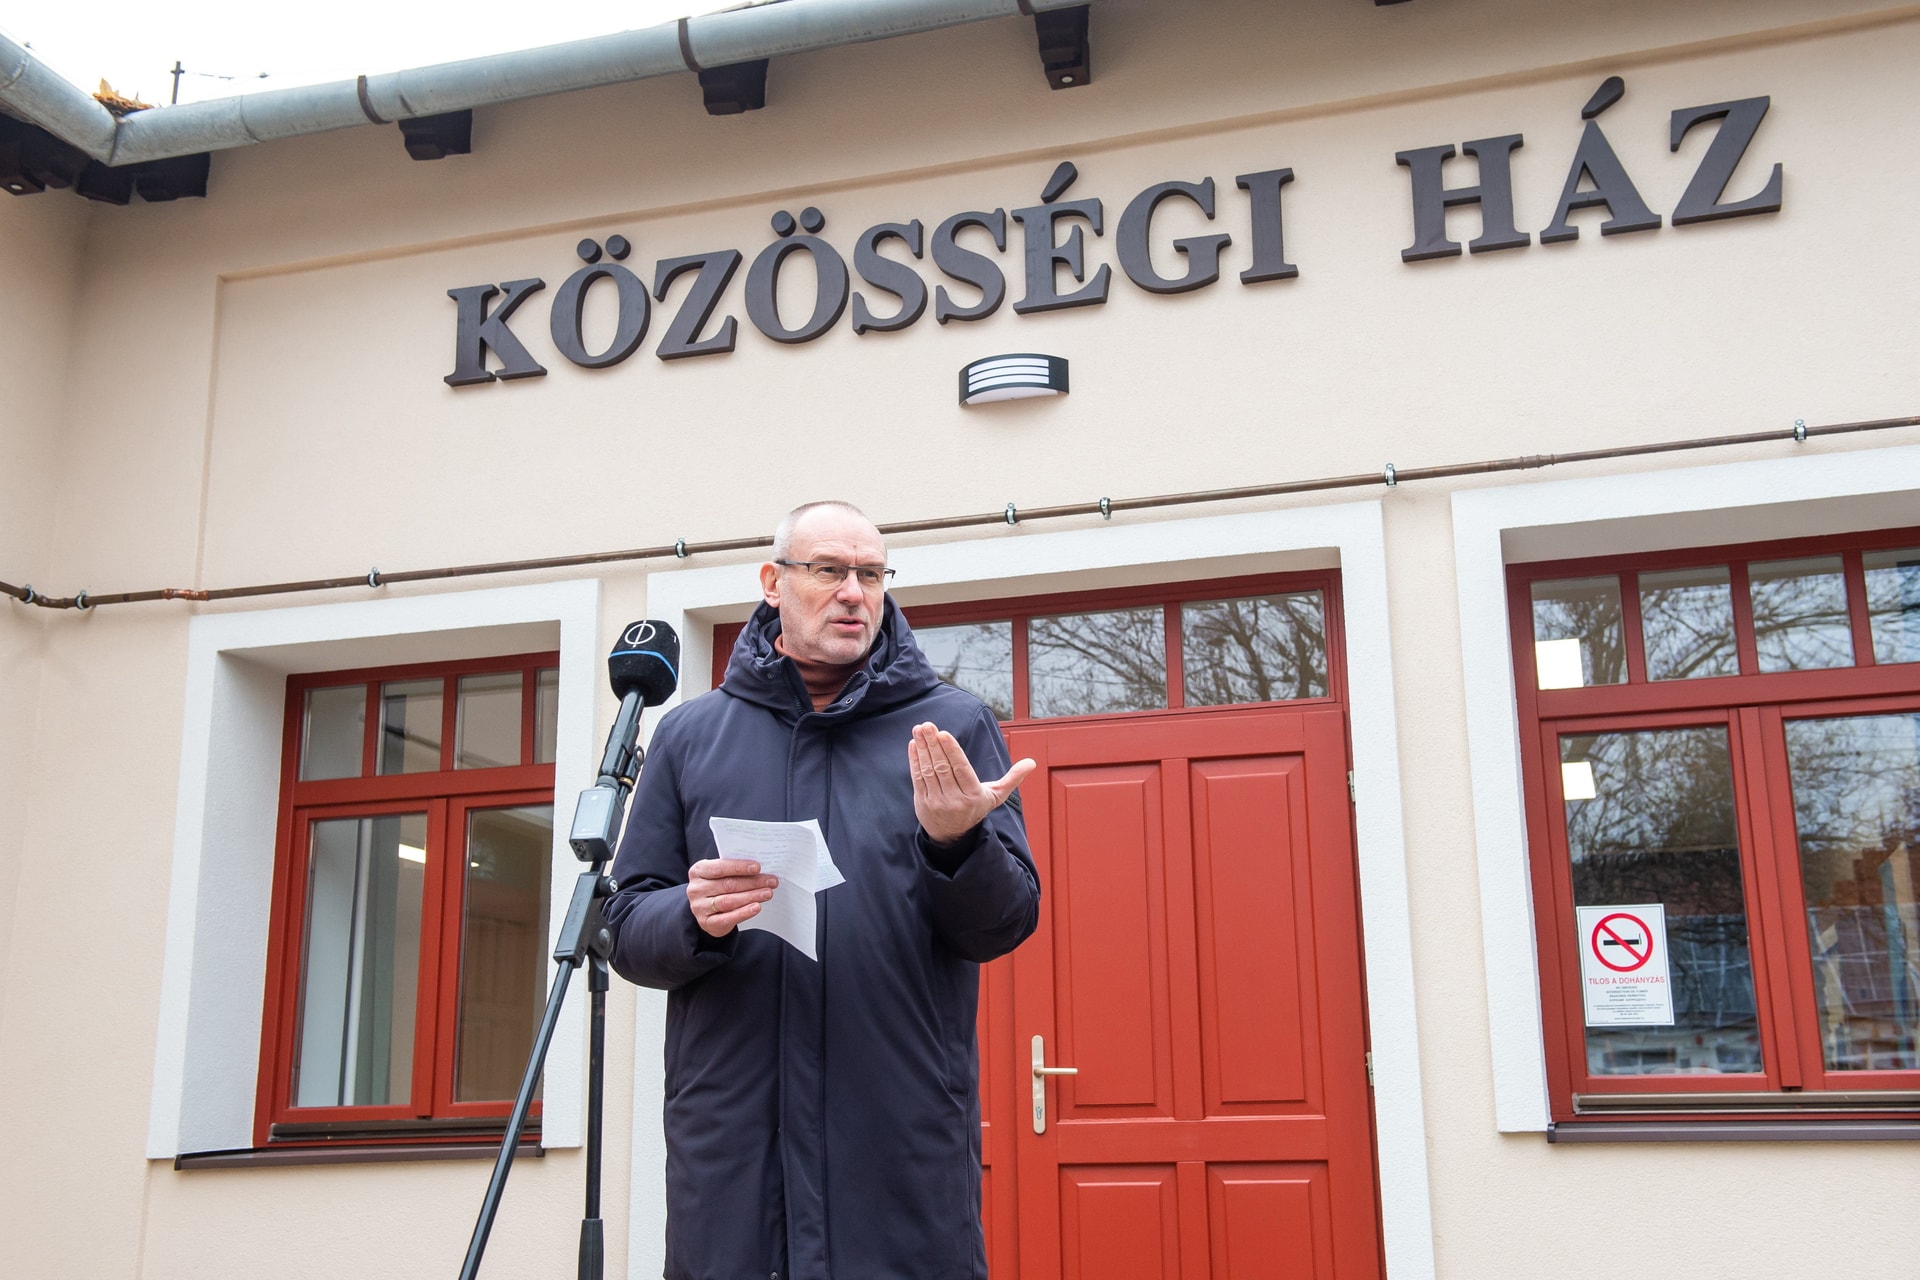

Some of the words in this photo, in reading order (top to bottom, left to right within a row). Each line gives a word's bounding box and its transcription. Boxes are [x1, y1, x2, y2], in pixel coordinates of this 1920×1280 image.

[444, 161, 1298, 387] KÖZÖSSÉGI
[1395, 75, 1783, 263] HÁZ
[1588, 977, 1610, 985] TILOS
[1611, 977, 1617, 985] A
